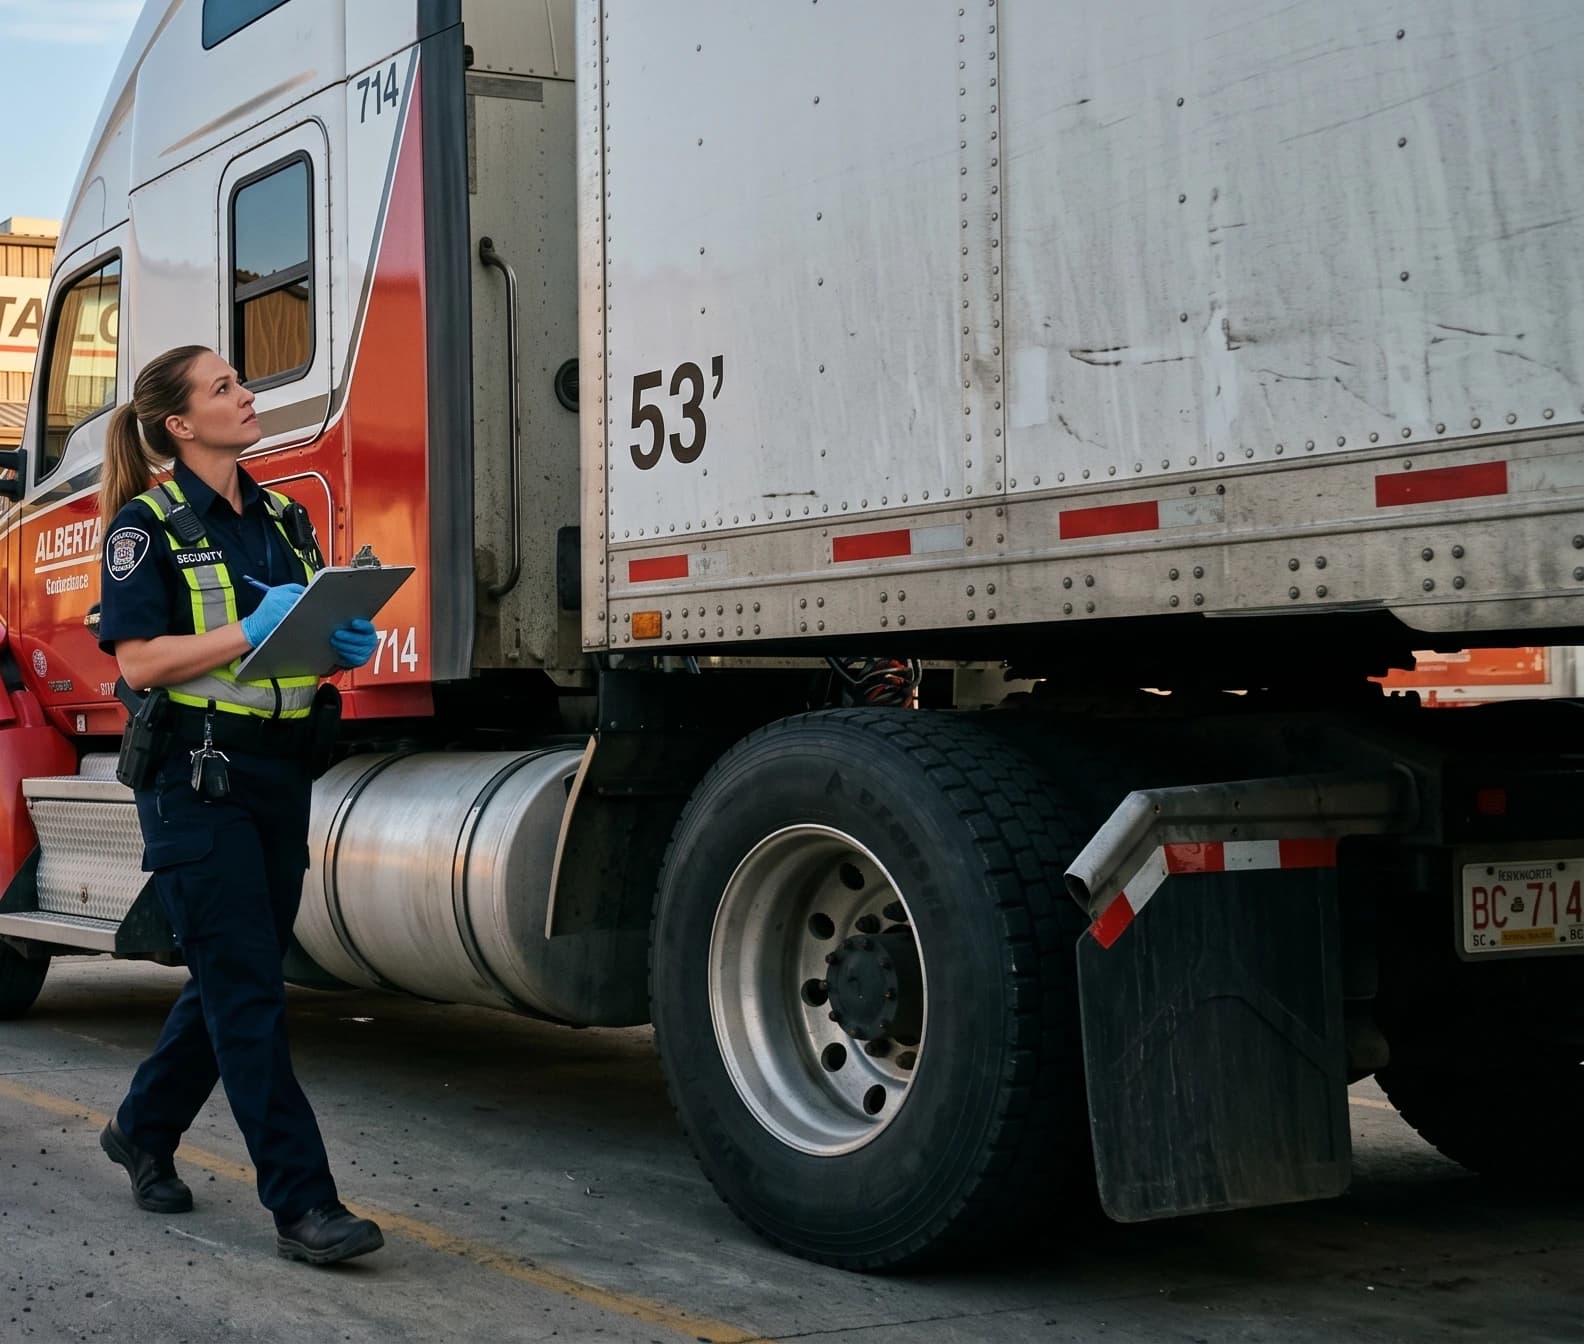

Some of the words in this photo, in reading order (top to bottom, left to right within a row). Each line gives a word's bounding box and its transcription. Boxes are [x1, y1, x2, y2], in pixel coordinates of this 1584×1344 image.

[357, 62, 399, 124] 714
[34, 516, 102, 564] ALBERTA
[373, 626, 418, 675] 714
[1472, 885, 1508, 930] BC
[1526, 880, 1584, 926] 714
